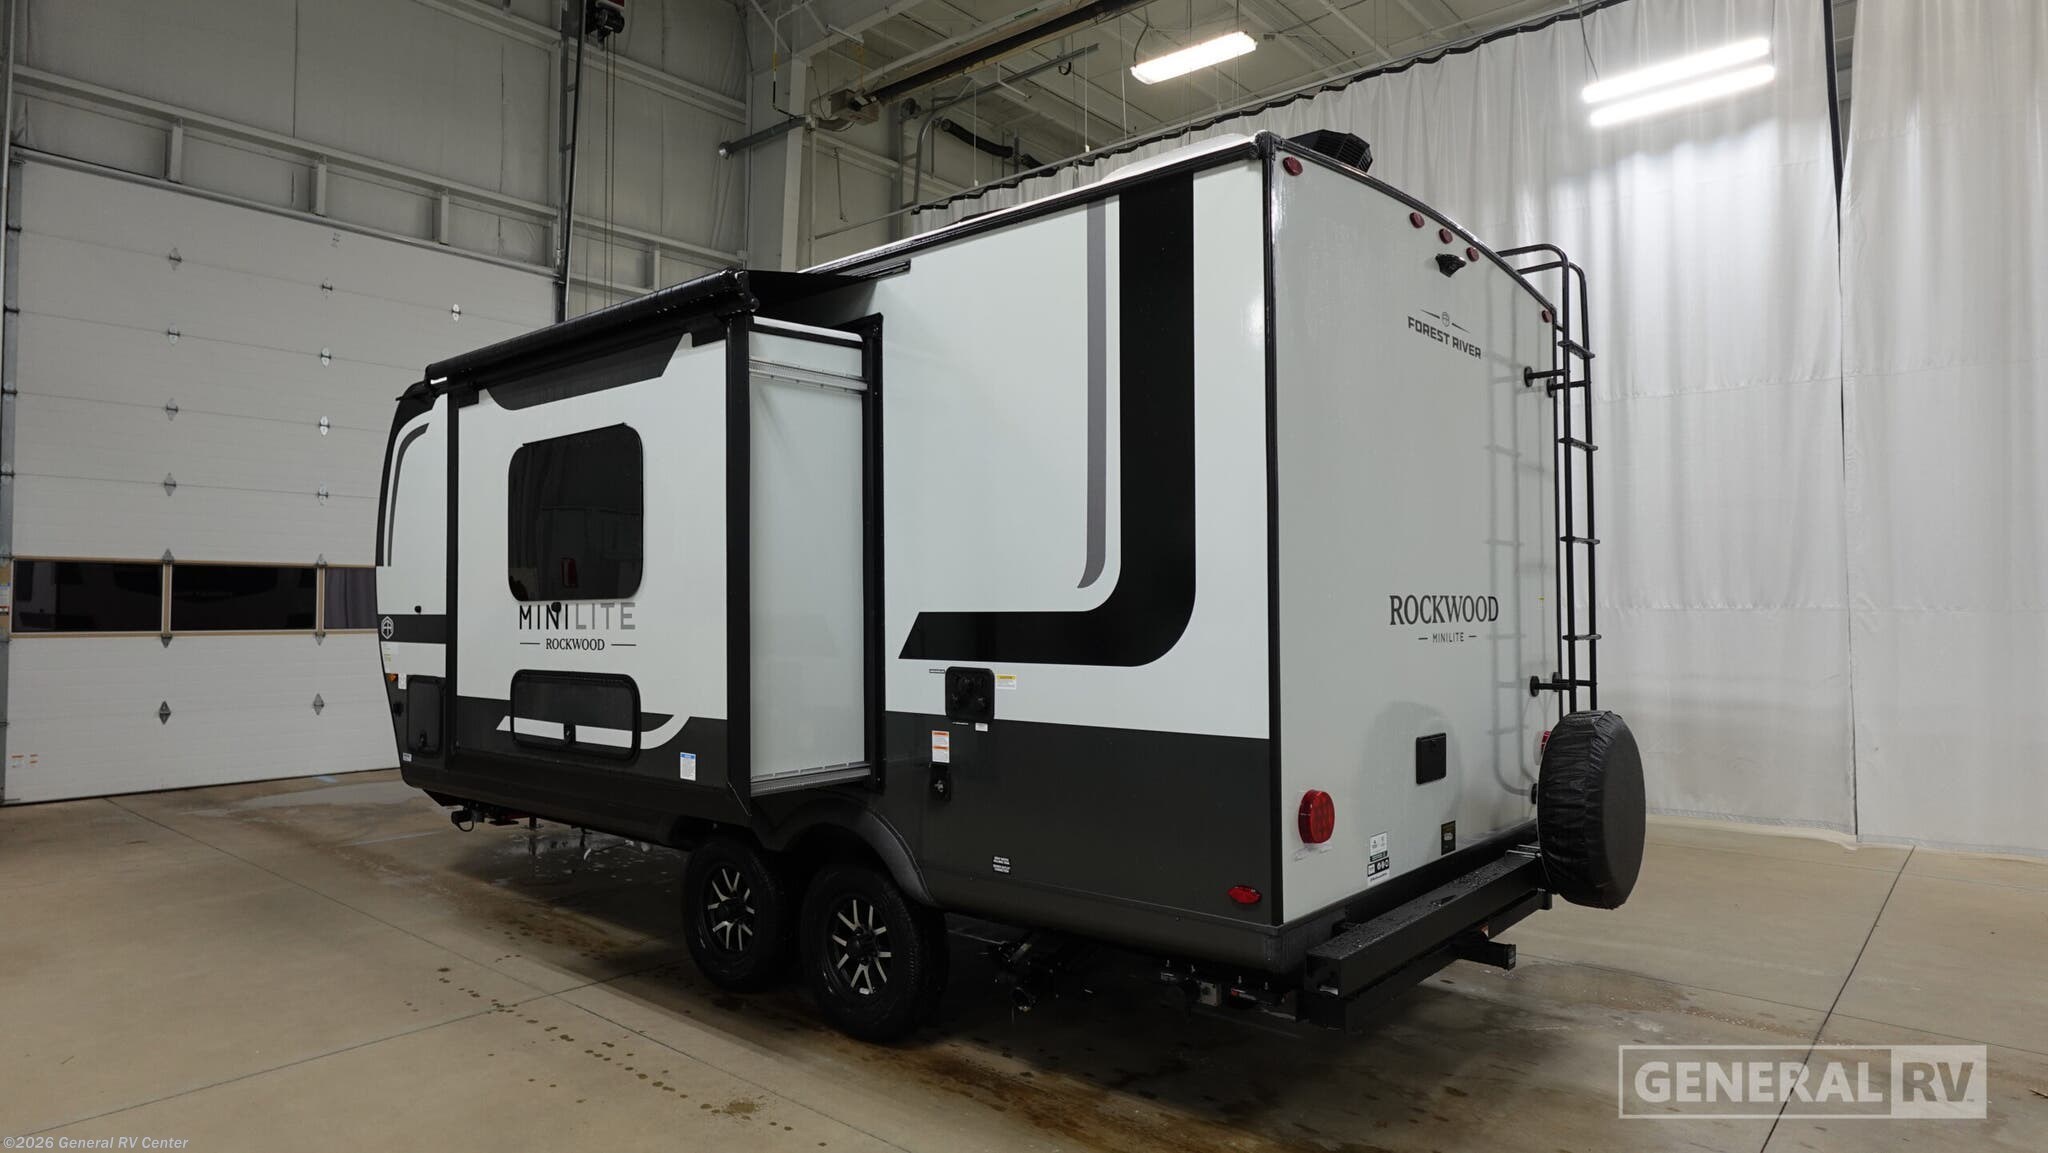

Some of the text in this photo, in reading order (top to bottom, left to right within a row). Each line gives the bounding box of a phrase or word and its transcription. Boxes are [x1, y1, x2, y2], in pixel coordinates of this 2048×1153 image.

[1407, 315, 1482, 360] FOREST RIVER
[519, 601, 636, 630] MINILITE
[1389, 594, 1500, 626] ROCKWOOD
[545, 638, 606, 651] ROCKWOOD
[1432, 632, 1465, 643] MINILITE
